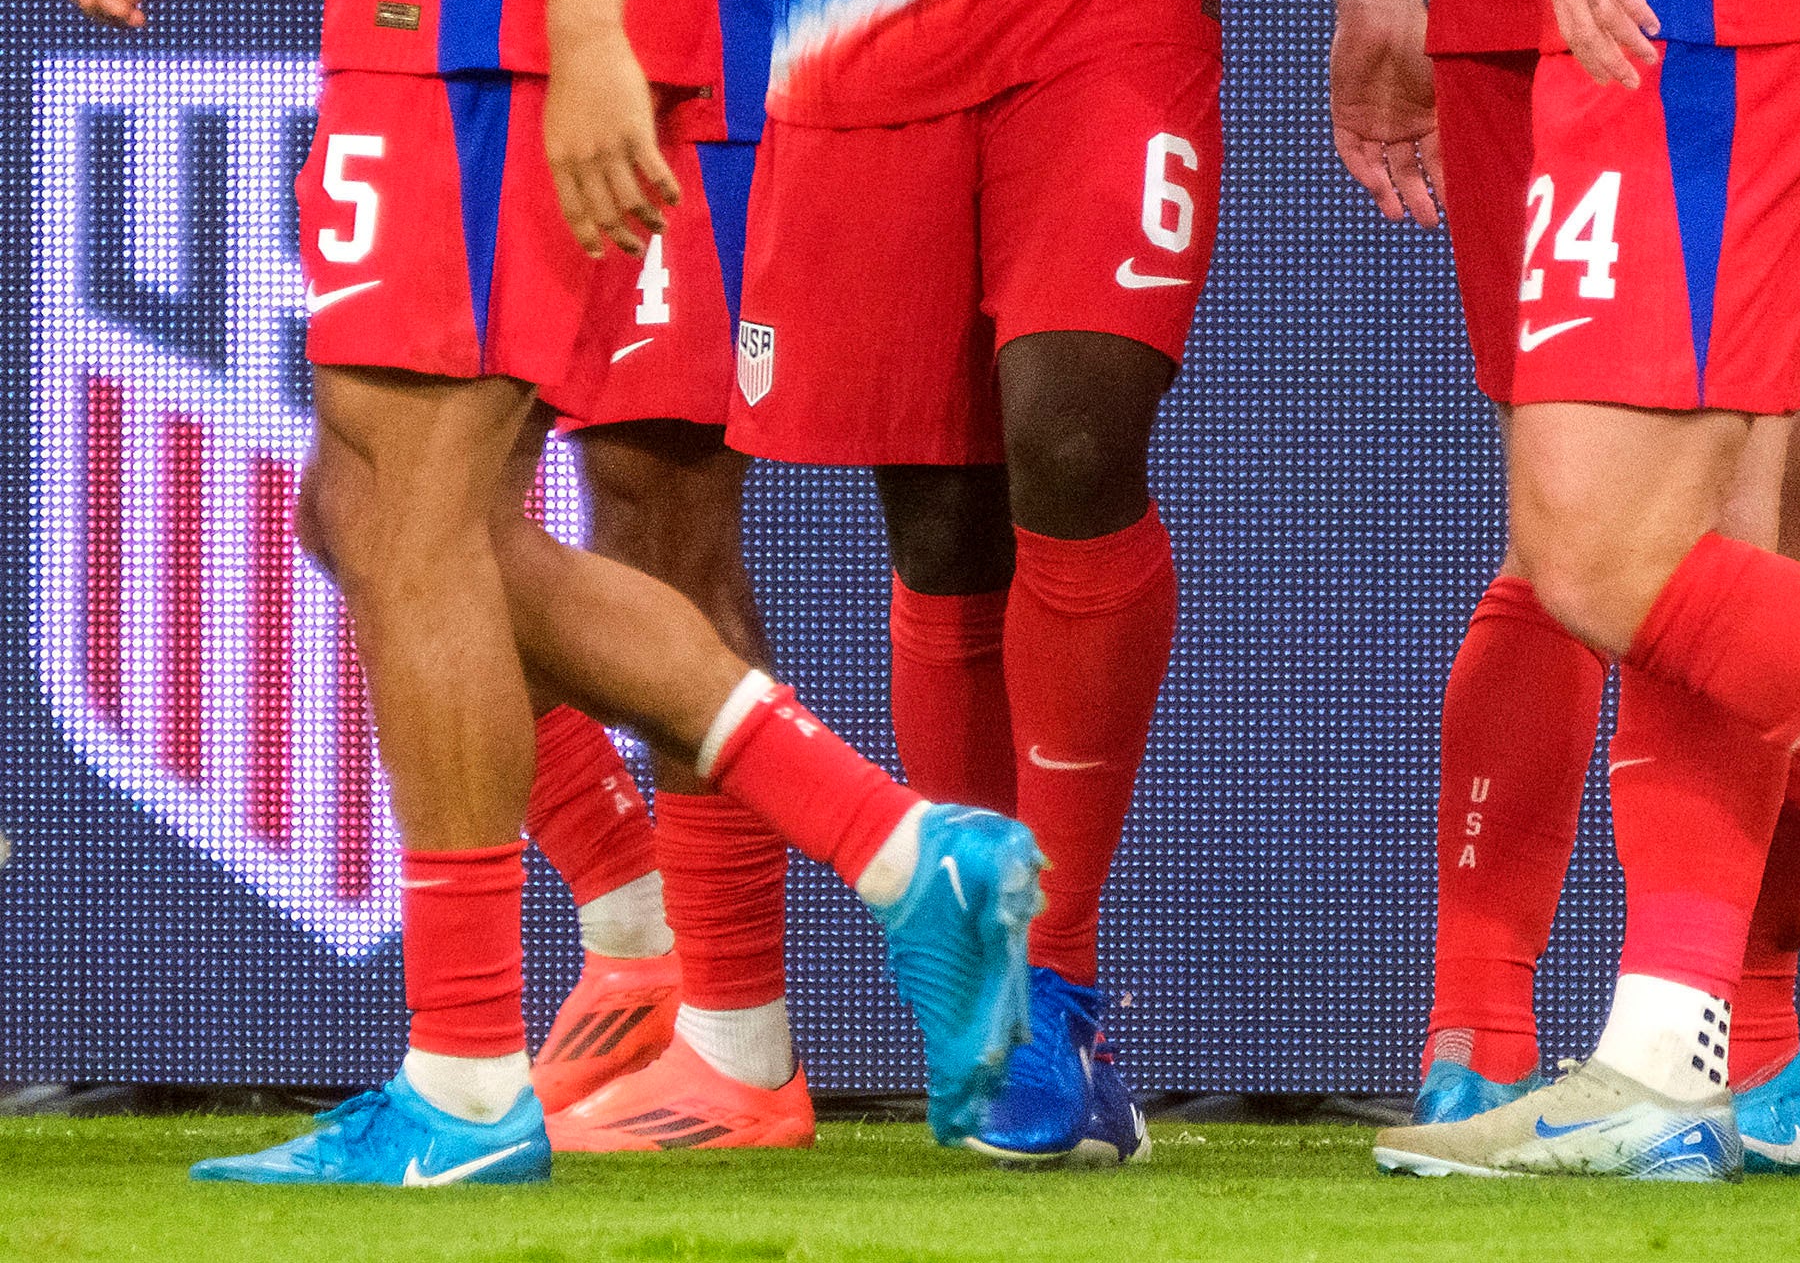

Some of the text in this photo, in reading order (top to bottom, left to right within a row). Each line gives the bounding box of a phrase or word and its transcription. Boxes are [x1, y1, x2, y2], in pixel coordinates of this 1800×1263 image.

[317, 134, 384, 263] 5
[1142, 131, 1199, 254] 6
[1519, 170, 1622, 302] 24
[740, 324, 772, 359] USA
[1459, 776, 1490, 869] USA
